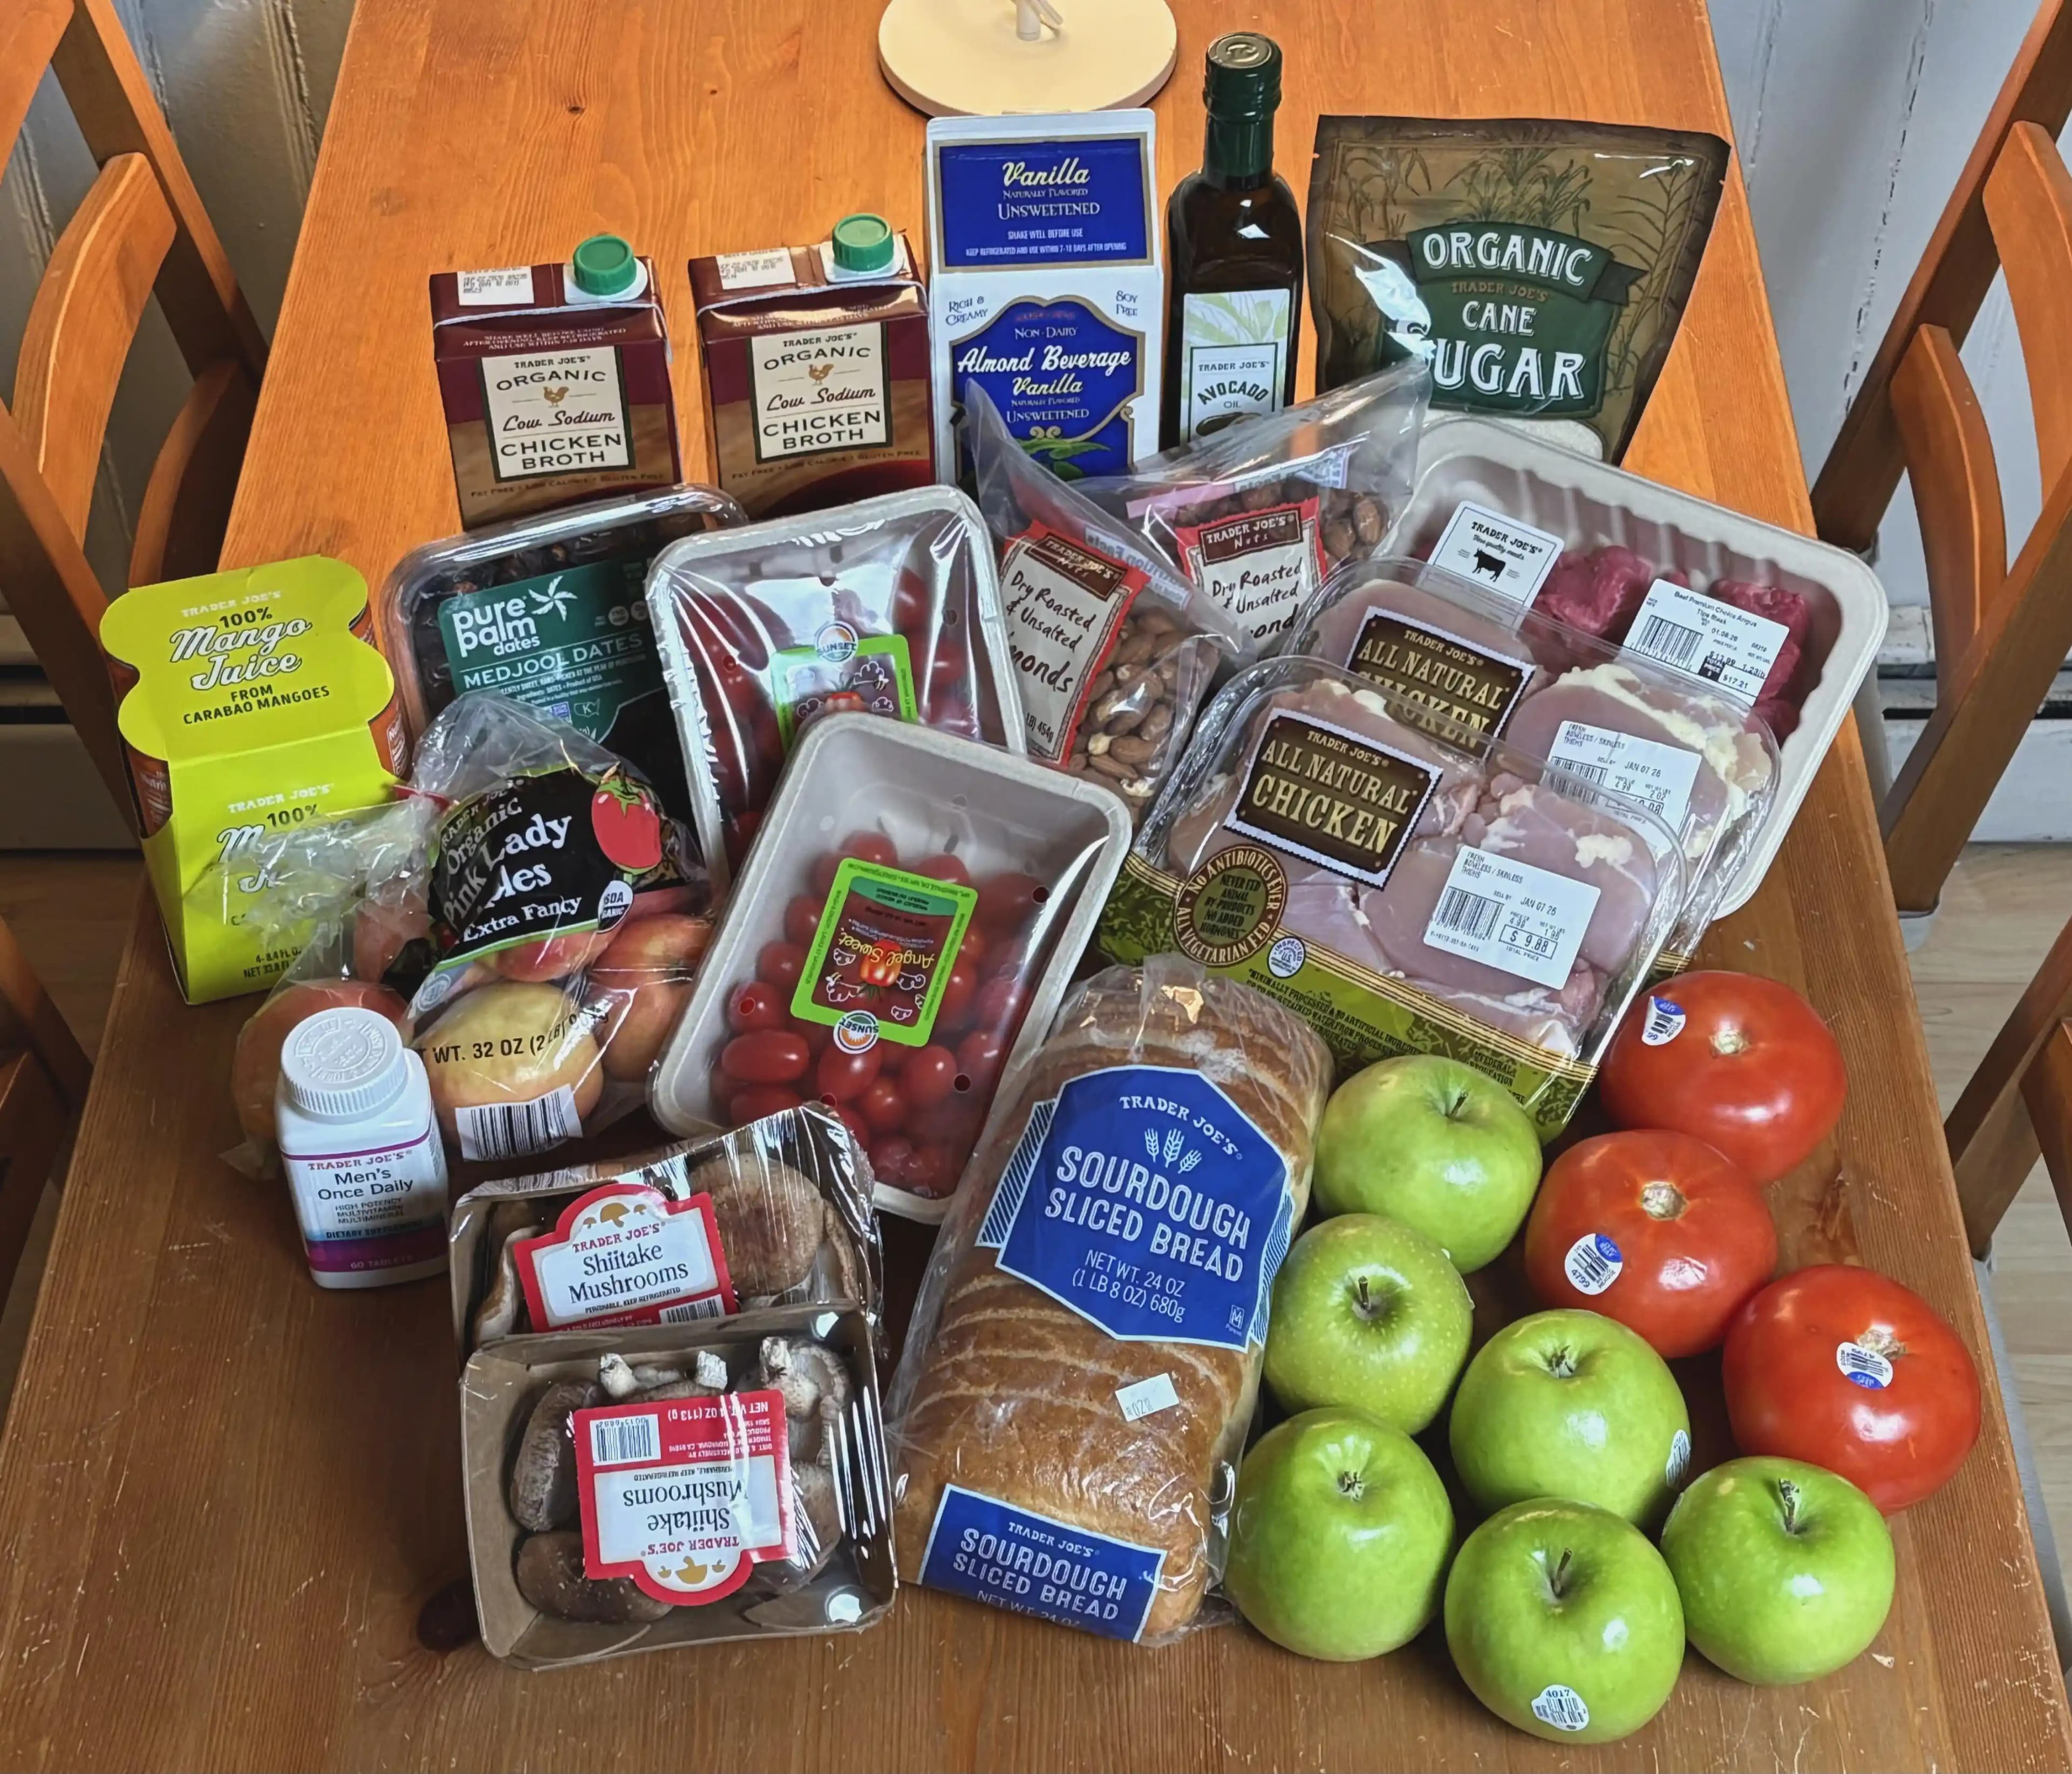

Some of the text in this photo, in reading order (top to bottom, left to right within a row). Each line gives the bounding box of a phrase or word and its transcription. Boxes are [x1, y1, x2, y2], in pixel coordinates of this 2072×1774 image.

[1003, 158, 1090, 186] Vanilla
[998, 203, 1100, 220] UNSWEETENED
[1008, 228, 1083, 240] SHAKE WELL BEFORE USE
[1422, 232, 1593, 287] ORGANIC
[1116, 290, 1137, 303] SOY
[1451, 282, 1504, 296] TRADER
[945, 309, 989, 325] CREAMY
[948, 298, 973, 313] RICH
[1116, 305, 1137, 316] FREE
[1462, 301, 1536, 336] CANE
[783, 333, 858, 347] TRADER JOE'S
[514, 356, 590, 369] TRADER JOE'S
[764, 347, 871, 370] ORGANIC
[957, 345, 1132, 376] Almond Beverage
[1198, 361, 1270, 371] TRADER JOE'S
[496, 370, 606, 391] ORGANIC
[1012, 373, 1083, 396] Vanilla
[767, 388, 876, 411] Low Sodium
[1197, 380, 1269, 405] AVOCADO
[1006, 409, 1089, 423] UNSWEETENED
[1224, 400, 1241, 409] OIL
[503, 410, 615, 432] Low Sodium
[763, 410, 881, 437] CHICKEN
[501, 434, 621, 456] CHICKEN
[783, 429, 864, 449] BROTH
[522, 451, 605, 470] BROTH
[1205, 524, 1251, 545] TRADER
[1471, 521, 1543, 554] TRADER JOE'S
[1241, 556, 1303, 588] Roasted
[181, 590, 281, 617] TRADER JOE'S
[1011, 570, 1097, 633] Dry Roasted
[1236, 581, 1299, 615] Unsalted
[1689, 596, 1714, 610] Premium
[1715, 607, 1736, 619] Choice
[219, 606, 272, 629] 100%
[452, 596, 527, 630] pure
[169, 618, 313, 663] Mango
[456, 614, 537, 657] palm
[1021, 606, 1082, 653] Unsalted
[493, 635, 541, 656] dates
[1403, 629, 1444, 657] TRADER
[190, 652, 303, 691] Juice
[464, 633, 643, 689] MEDJOOL DATES
[1358, 638, 1510, 711] ALL NATURAL
[1723, 674, 1748, 689] $17.21
[230, 684, 274, 702] FROM
[182, 685, 330, 725] CARABAO MANGOES
[1306, 730, 1348, 754] TRADER
[1262, 739, 1419, 815] ALL NATURAL
[1624, 761, 1650, 774] JAN 07
[228, 784, 334, 814] TRADER JOE'S
[1251, 773, 1398, 855] CHICKEN
[445, 797, 523, 876] Organic
[480, 813, 572, 873] Lady
[1189, 847, 1282, 911] NO ANTIBIOTICS EVER
[1219, 874, 1262, 891] NEVER FED
[1204, 895, 1256, 915] BY-PRODUCTS
[1520, 896, 1557, 916] JAN 07 26
[463, 896, 583, 943] Extra Fancy
[1204, 910, 1247, 926] NO ADDED
[1177, 906, 1271, 963] ALL VEGETARIAN FED
[1510, 930, 1549, 953] $ 9.88
[838, 931, 884, 963] Sweet
[885, 949, 935, 969] Angel
[243, 966, 261, 978] NET
[839, 1017, 880, 1035] SUNSET
[433, 1035, 545, 1064] WT. 32 OZ (2
[1119, 1096, 1243, 1160] TRADER JOE'S
[307, 1150, 412, 1171] TRADER JOE'S
[334, 1168, 392, 1186] Men's
[317, 1180, 414, 1201] Once Daily
[1055, 1146, 1251, 1250] SOURDOUGH
[336, 1198, 402, 1211] HIGH POTENCY
[338, 1212, 404, 1225] MULTIMINERAL
[326, 1229, 362, 1239] DIETARY
[572, 1232, 623, 1254] TRADER
[1044, 1187, 1244, 1283] SLICED BREAD
[583, 1242, 664, 1276] Shiitake
[568, 1262, 689, 1304] Mushrooms
[1084, 1249, 1186, 1297] NET WT. 24 OZ
[1071, 1268, 1186, 1324] (1 LB 8 OZ) 680g
[667, 1402, 769, 1422] NET OZ (113 g)
[623, 1479, 749, 1507] Mushrooms
[648, 1506, 731, 1536] Shiitake
[646, 1536, 740, 1557] TRADER JOE'S
[1008, 1521, 1101, 1559] TRADER JOE'S
[959, 1527, 1128, 1601] SOURDOUGH
[953, 1553, 1119, 1621] SLICED BREAD
[977, 1590, 1007, 1607] NET
[1546, 1689, 1570, 1697] 4017
